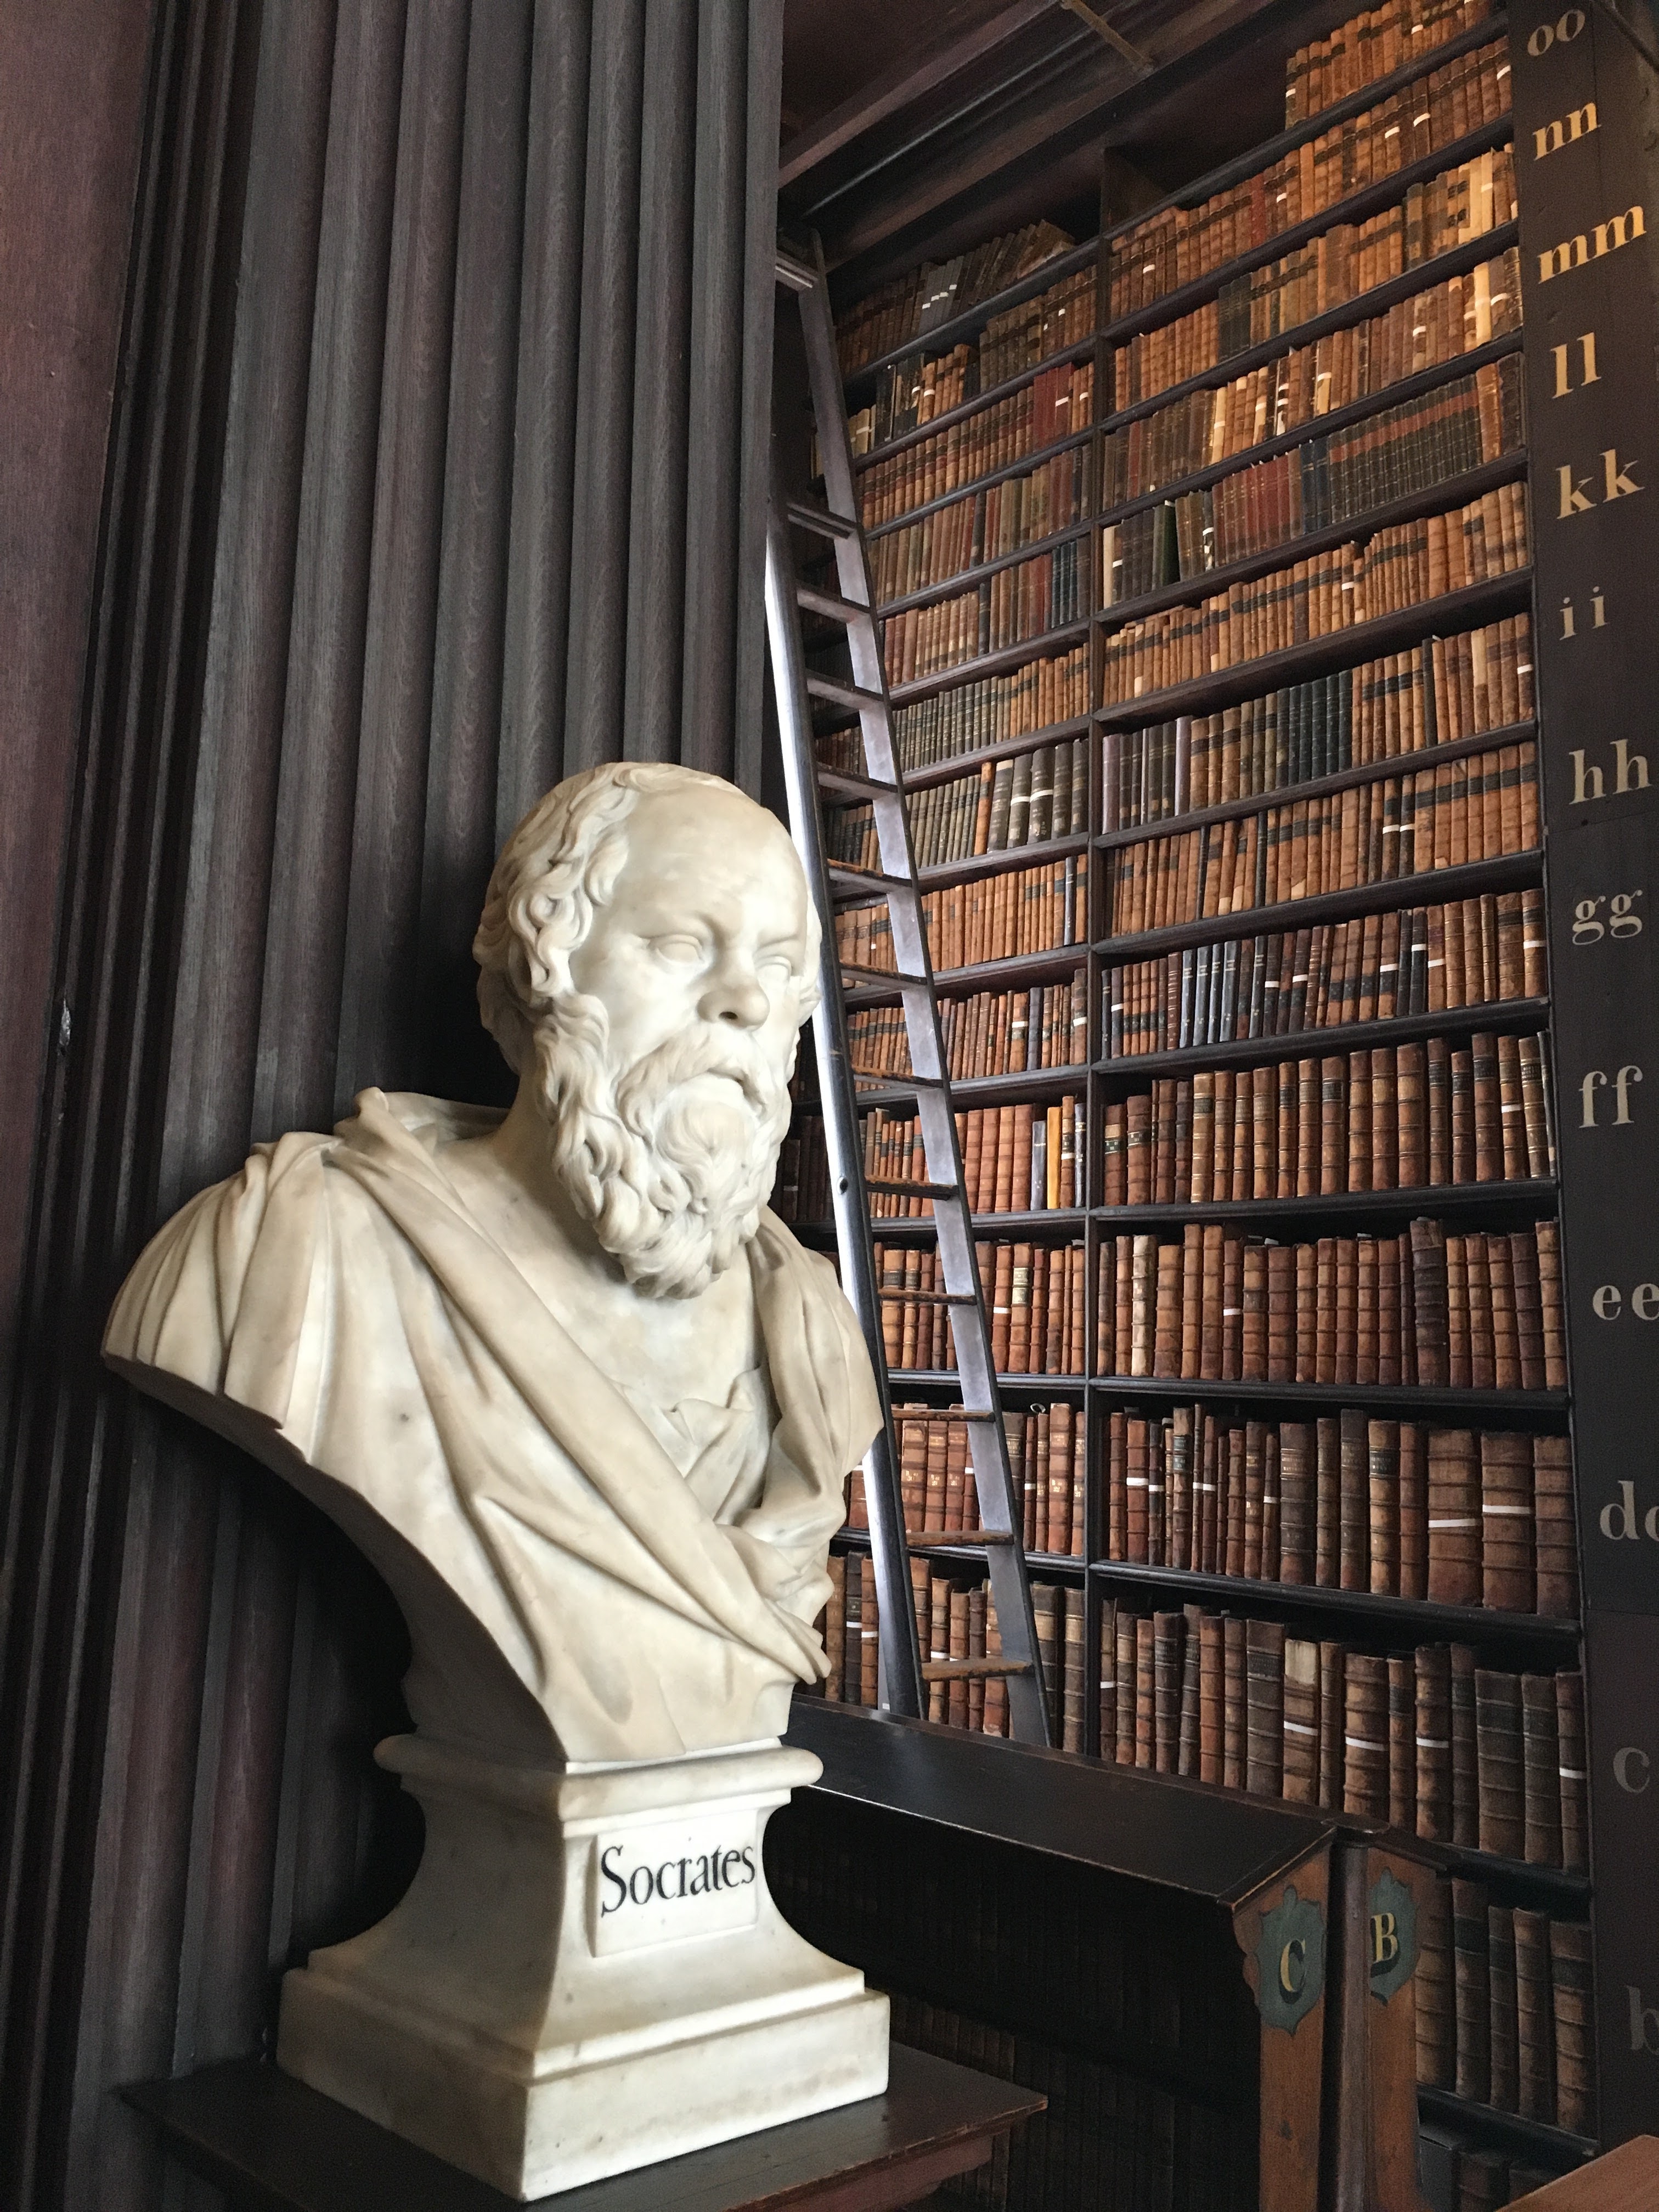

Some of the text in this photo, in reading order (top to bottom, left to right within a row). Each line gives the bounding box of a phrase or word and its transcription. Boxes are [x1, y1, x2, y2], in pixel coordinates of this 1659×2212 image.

[1527, 9, 1585, 56] oo
[1532, 103, 1601, 160] nn
[1537, 206, 1646, 284] mm
[1550, 332, 1601, 399] ll
[1556, 449, 1645, 519] kk
[1568, 739, 1652, 805] hh
[1572, 889, 1643, 945] gg
[1579, 1065, 1643, 1128] ff
[601, 1844, 755, 1918] Socrates
[1279, 1938, 1306, 1994] C
[1372, 1912, 1398, 1965] B
